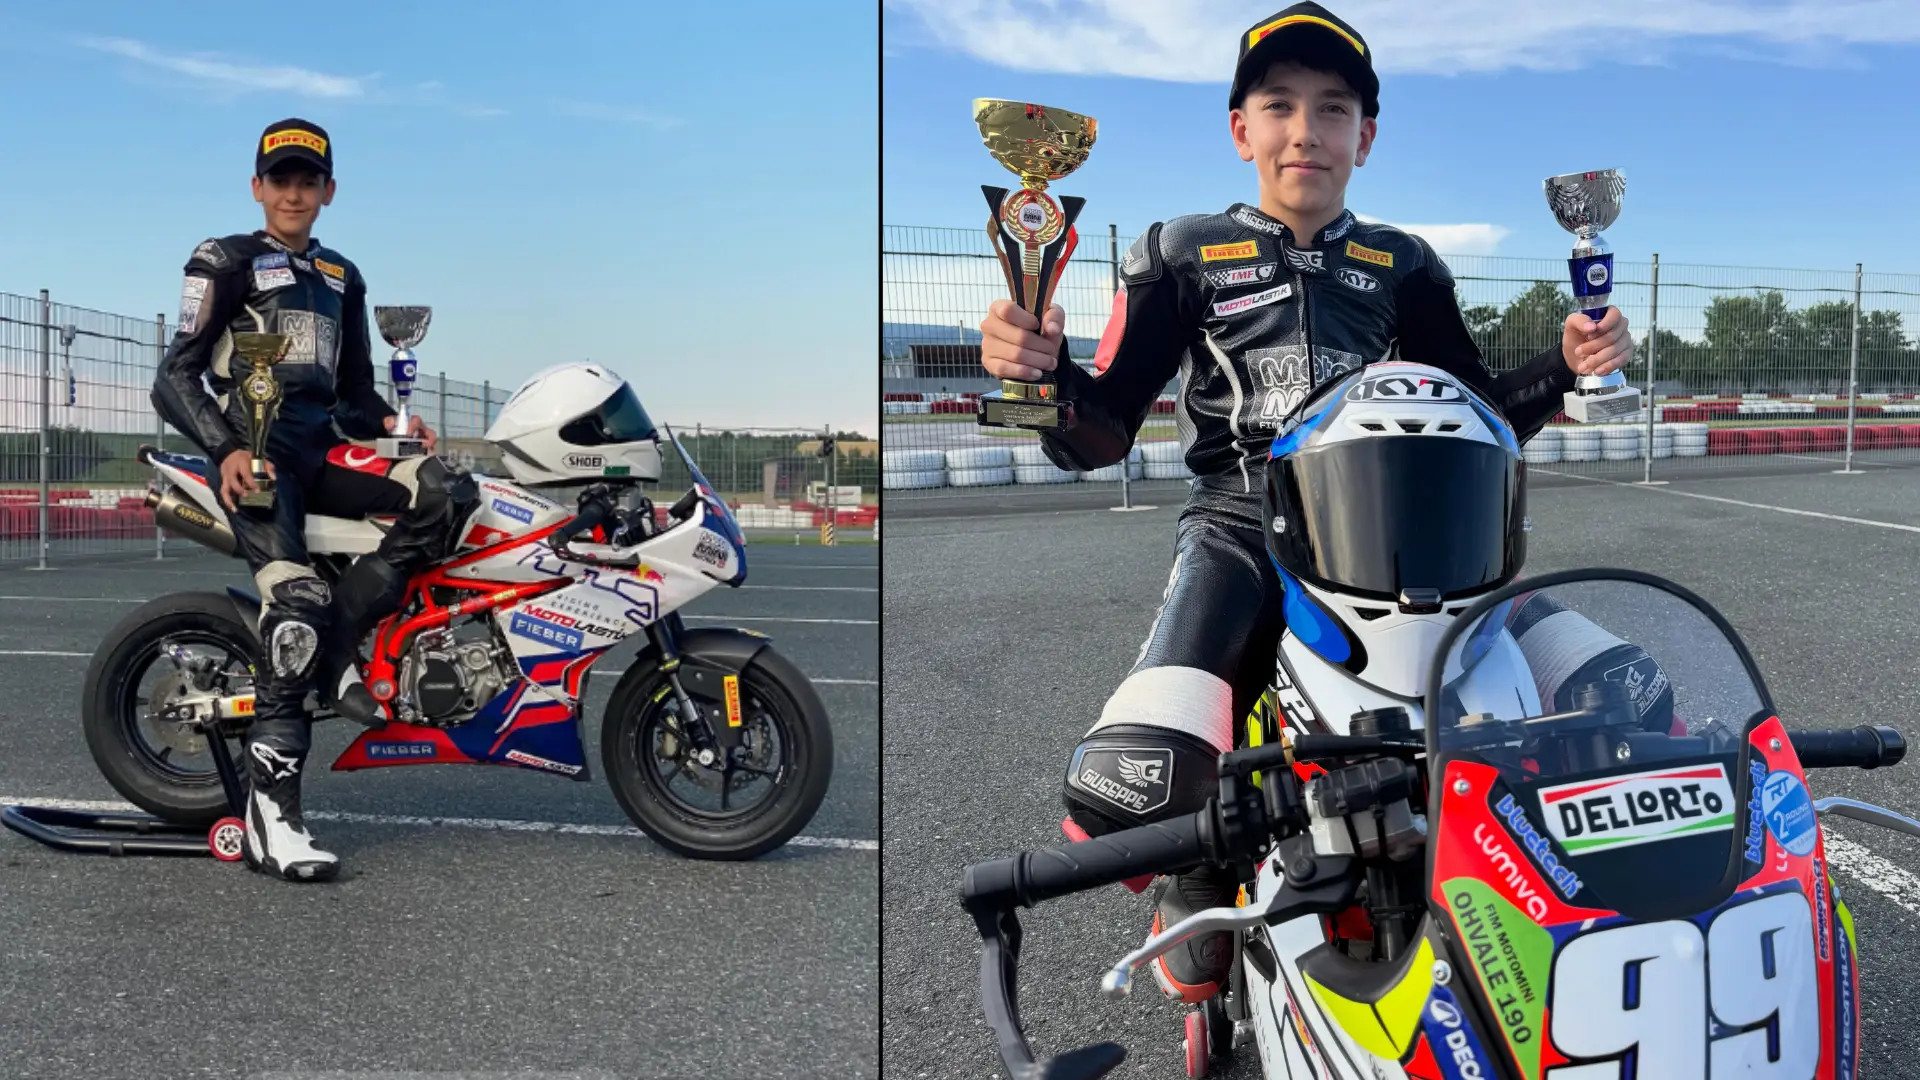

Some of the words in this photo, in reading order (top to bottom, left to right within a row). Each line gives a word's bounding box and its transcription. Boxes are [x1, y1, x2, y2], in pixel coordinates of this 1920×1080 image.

[1205, 243, 1253, 258] PIRELLI
[1349, 244, 1389, 264] PIRELLI
[1231, 269, 1255, 281] TMF
[1361, 378, 1456, 400] KYT
[568, 455, 602, 468] SHOEI
[515, 618, 579, 647] FIEBER
[370, 743, 433, 756] FIEBER
[1559, 784, 1723, 838] DELLORTO
[1744, 758, 1767, 865] bluetech
[1773, 810, 1790, 840] 2
[1495, 792, 1583, 899] bluetech
[1453, 891, 1509, 991] OHVALE
[1496, 992, 1532, 1044] 190
[1484, 903, 1503, 931] FIM
[1496, 931, 1536, 1004] MOTOMINI
[1551, 889, 1820, 1080] 99
[1837, 926, 1851, 1057] DECATHLON
[1446, 1029, 1485, 1080] DEC
